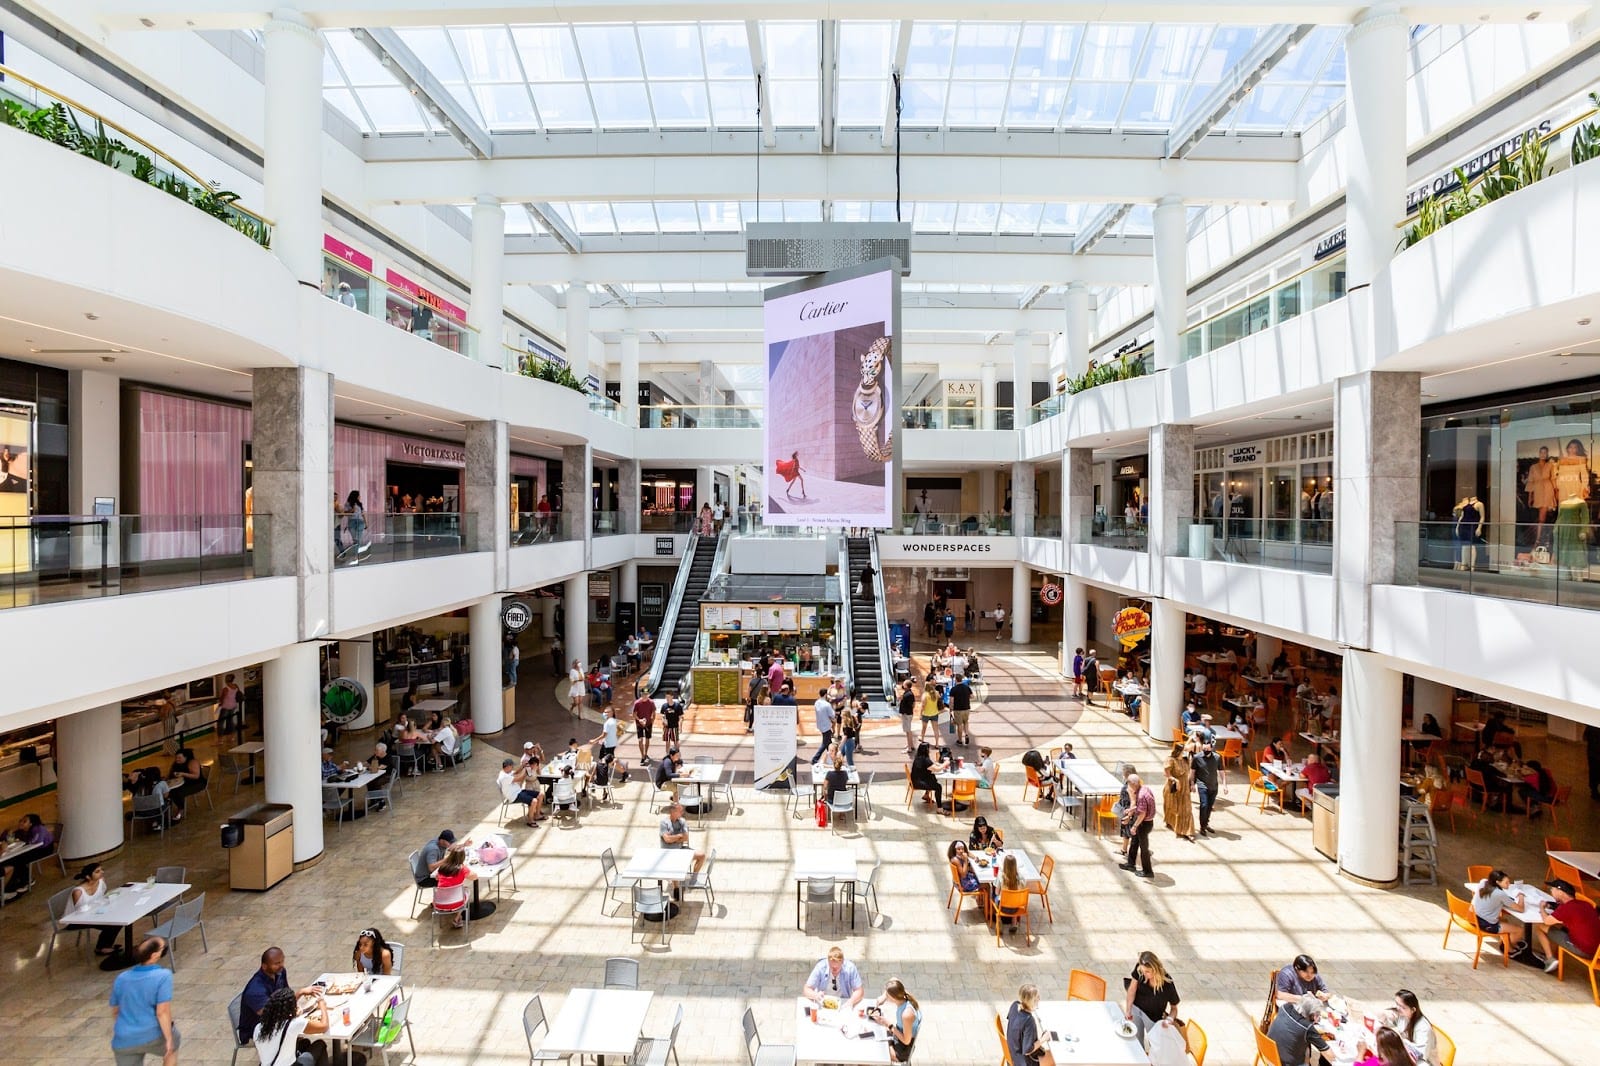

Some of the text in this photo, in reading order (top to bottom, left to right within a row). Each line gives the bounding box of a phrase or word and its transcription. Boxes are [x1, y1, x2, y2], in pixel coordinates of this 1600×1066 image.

[1433, 119, 1551, 193] OUTFITTERS
[799, 301, 848, 321] Cartier
[948, 383, 976, 391] KAY
[402, 442, 450, 460] VICTORIA'S
[1233, 446, 1256, 456] LUCKY
[1233, 454, 1256, 464] BRAND
[903, 544, 991, 552] WONDERSPACES
